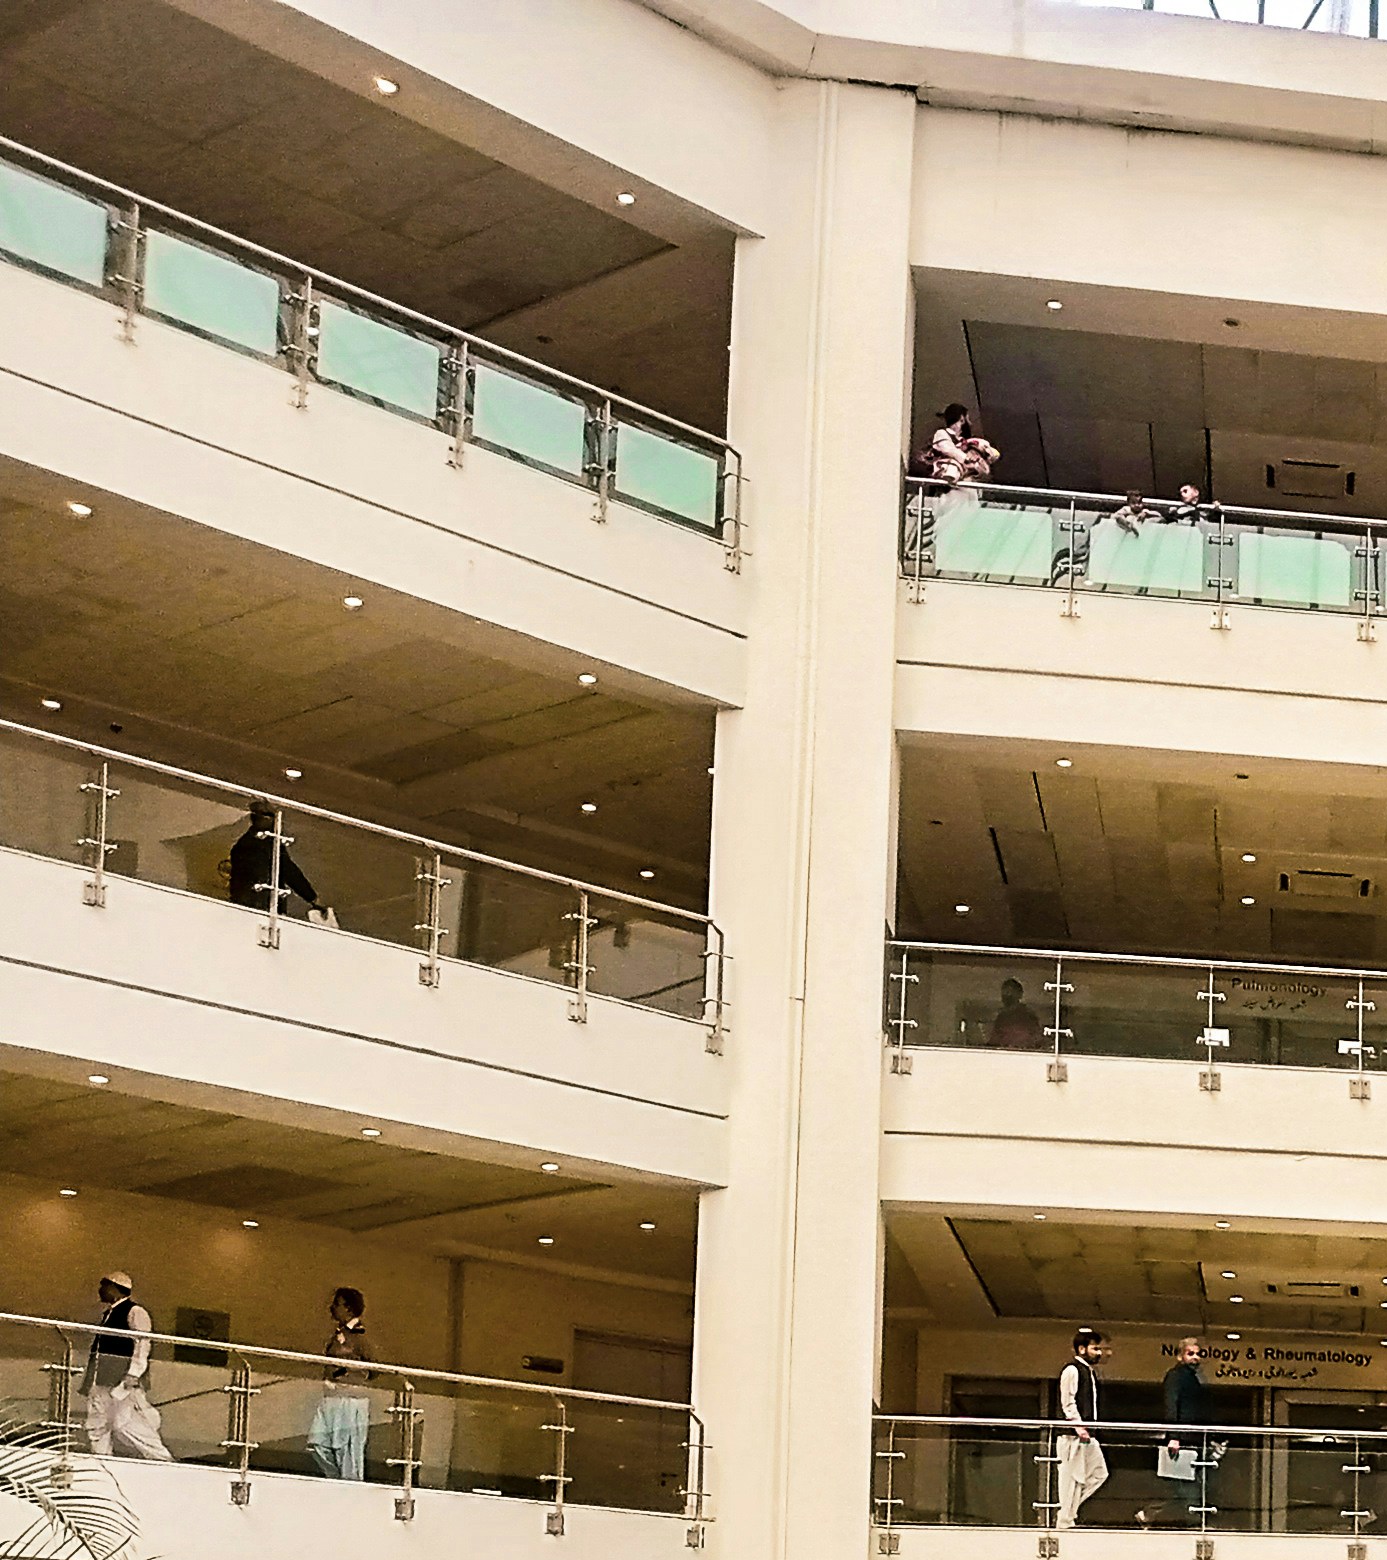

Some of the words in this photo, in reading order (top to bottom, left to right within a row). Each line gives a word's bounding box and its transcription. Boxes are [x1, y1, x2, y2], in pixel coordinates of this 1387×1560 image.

[1231, 977, 1327, 998] Pulmonology
[1162, 1344, 1240, 1361] Nology
[1246, 1347, 1257, 1360] &
[1264, 1347, 1372, 1367] Rheumatology
